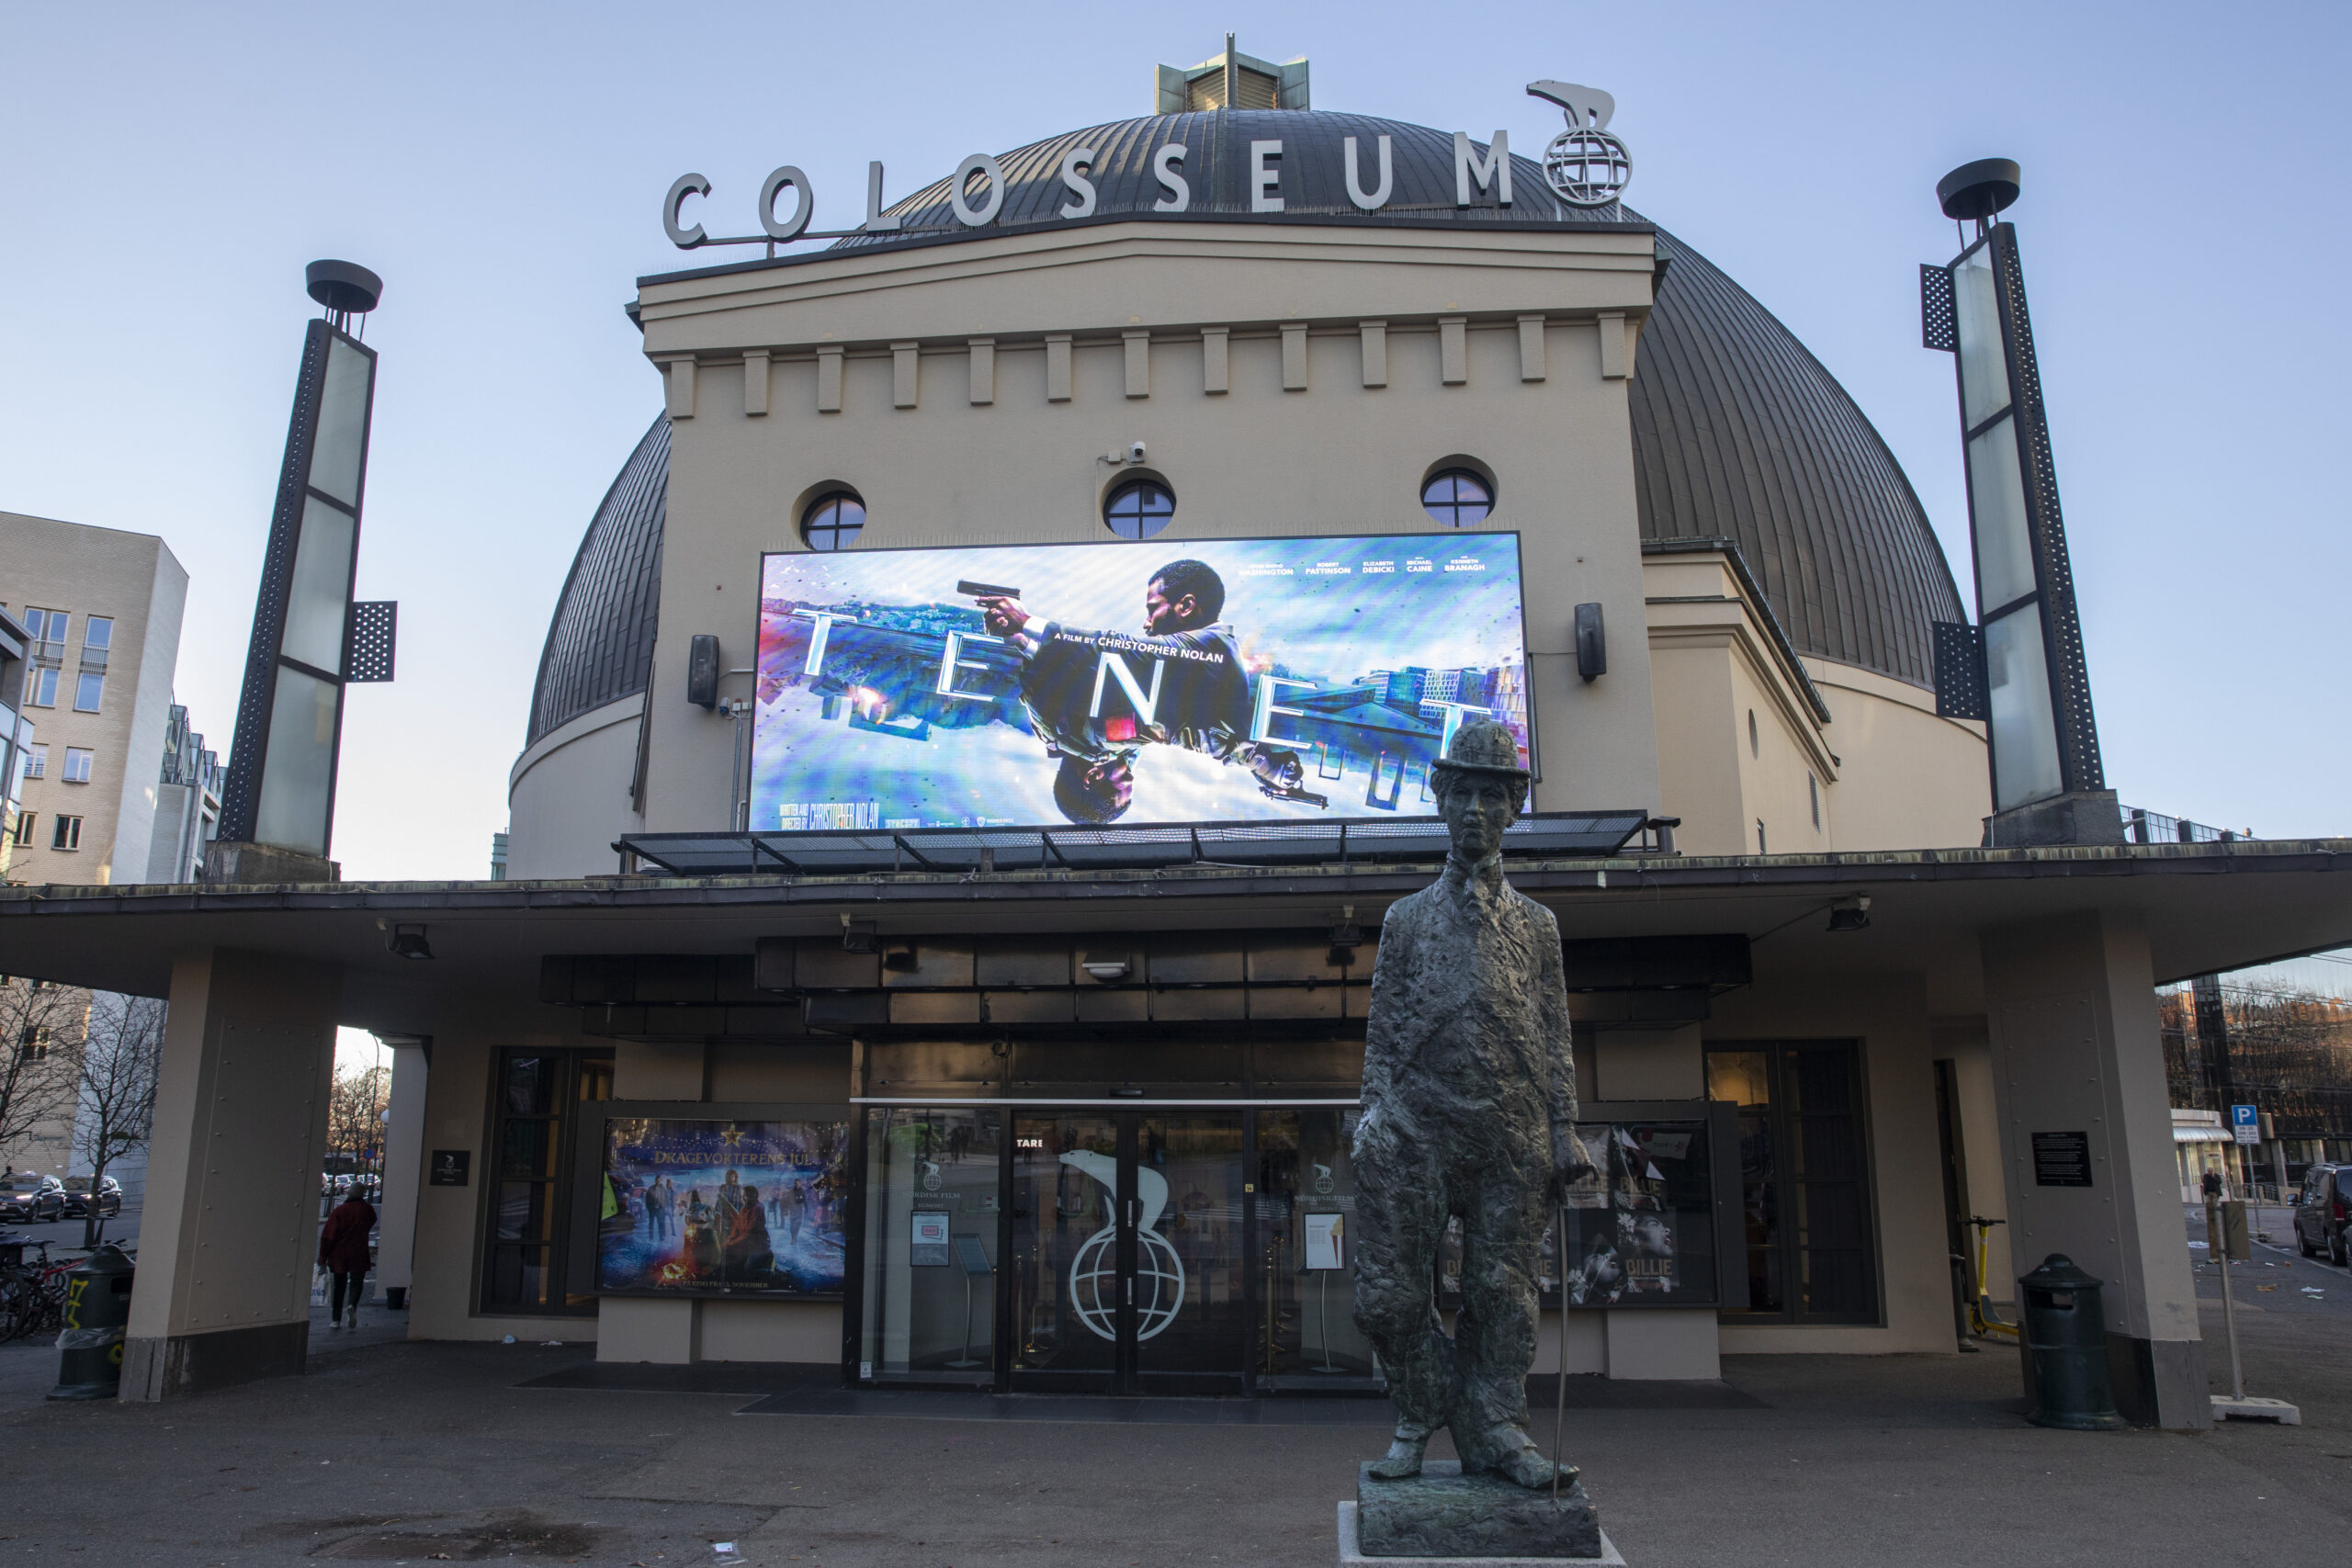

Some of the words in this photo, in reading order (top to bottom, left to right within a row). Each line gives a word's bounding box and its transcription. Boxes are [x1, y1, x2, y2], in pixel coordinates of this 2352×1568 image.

[662, 130, 1512, 251] COLOSEUM
[1063, 634, 1082, 643] FILM
[1084, 637, 1095, 645] BY
[1098, 637, 1177, 657] CHRISTOPHER
[1180, 649, 1224, 663] NOLAN
[791, 608, 1492, 760] TENET
[809, 803, 854, 829] CHRISTOPHER
[856, 803, 879, 829] NOLAN
[2237, 1108, 2251, 1123] P
[654, 1150, 786, 1165] DRAGEVOKTERENS
[789, 1153, 812, 1167] JUL
[1625, 1258, 1673, 1276] BILLIE
